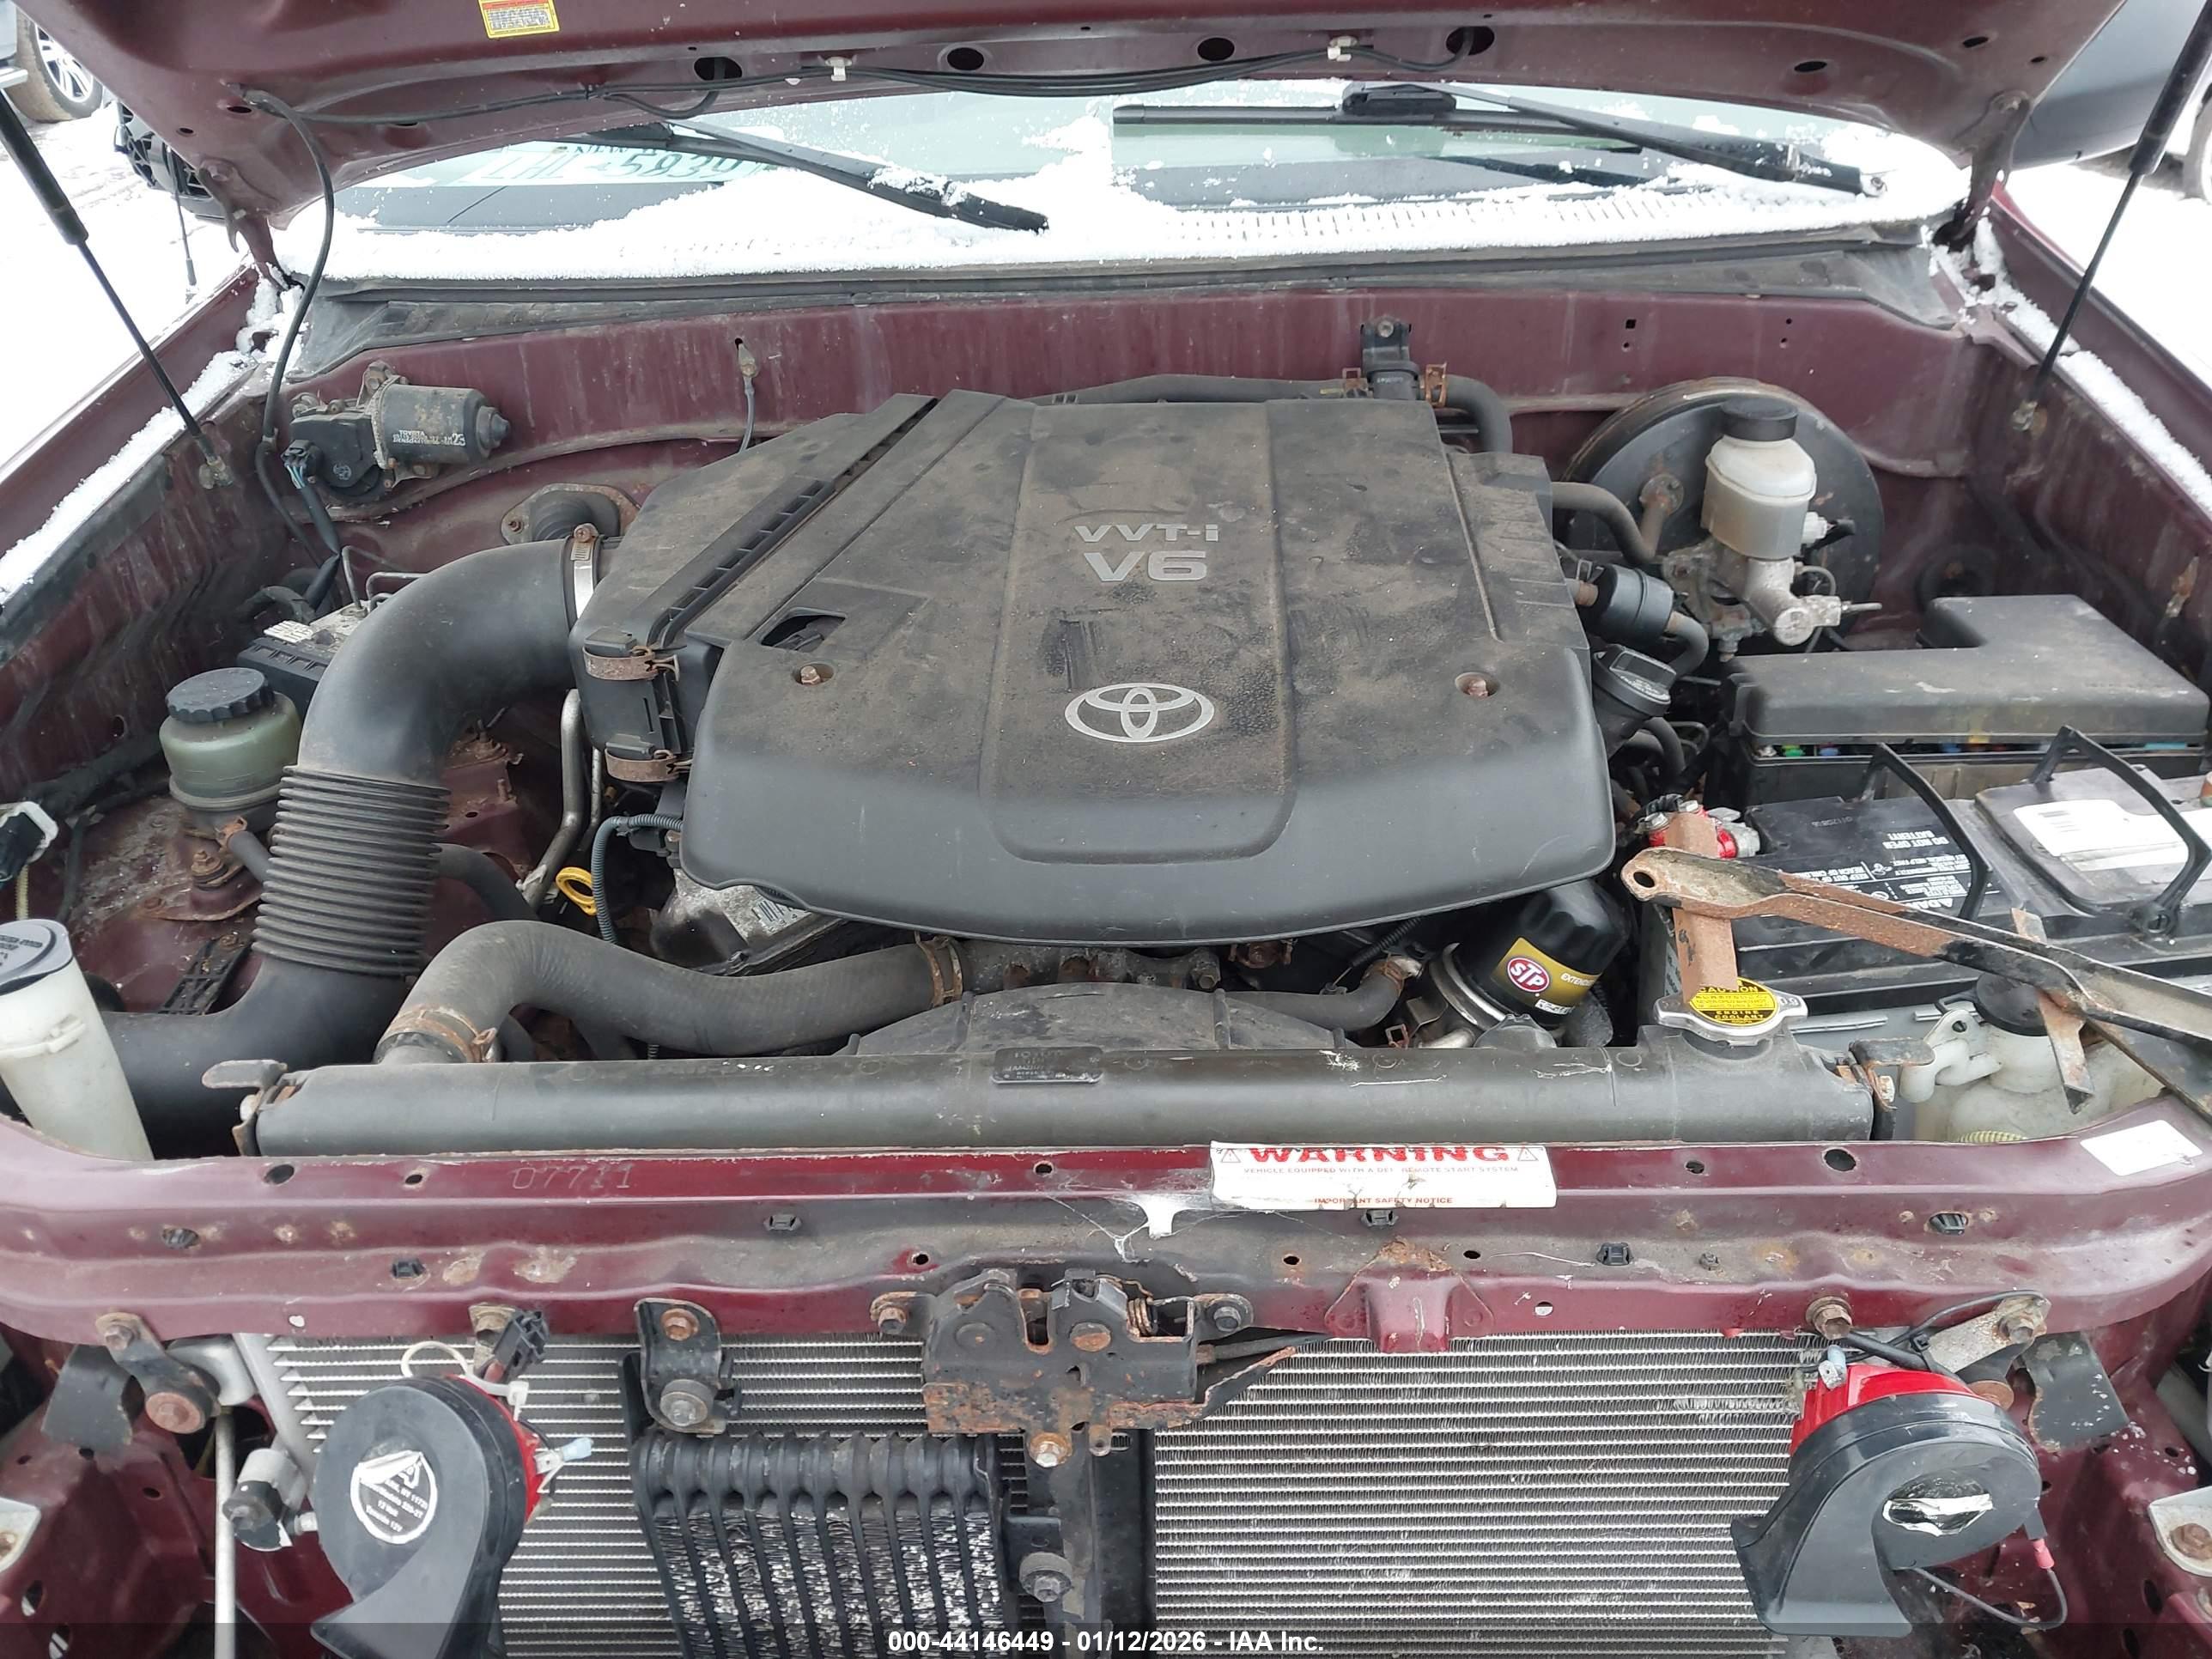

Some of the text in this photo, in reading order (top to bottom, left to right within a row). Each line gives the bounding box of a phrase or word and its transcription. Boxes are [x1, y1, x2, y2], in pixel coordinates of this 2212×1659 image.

[1084, 550, 1207, 581] V6
[1510, 963, 1546, 987] STP
[1249, 1146, 1510, 1163] WARNING
